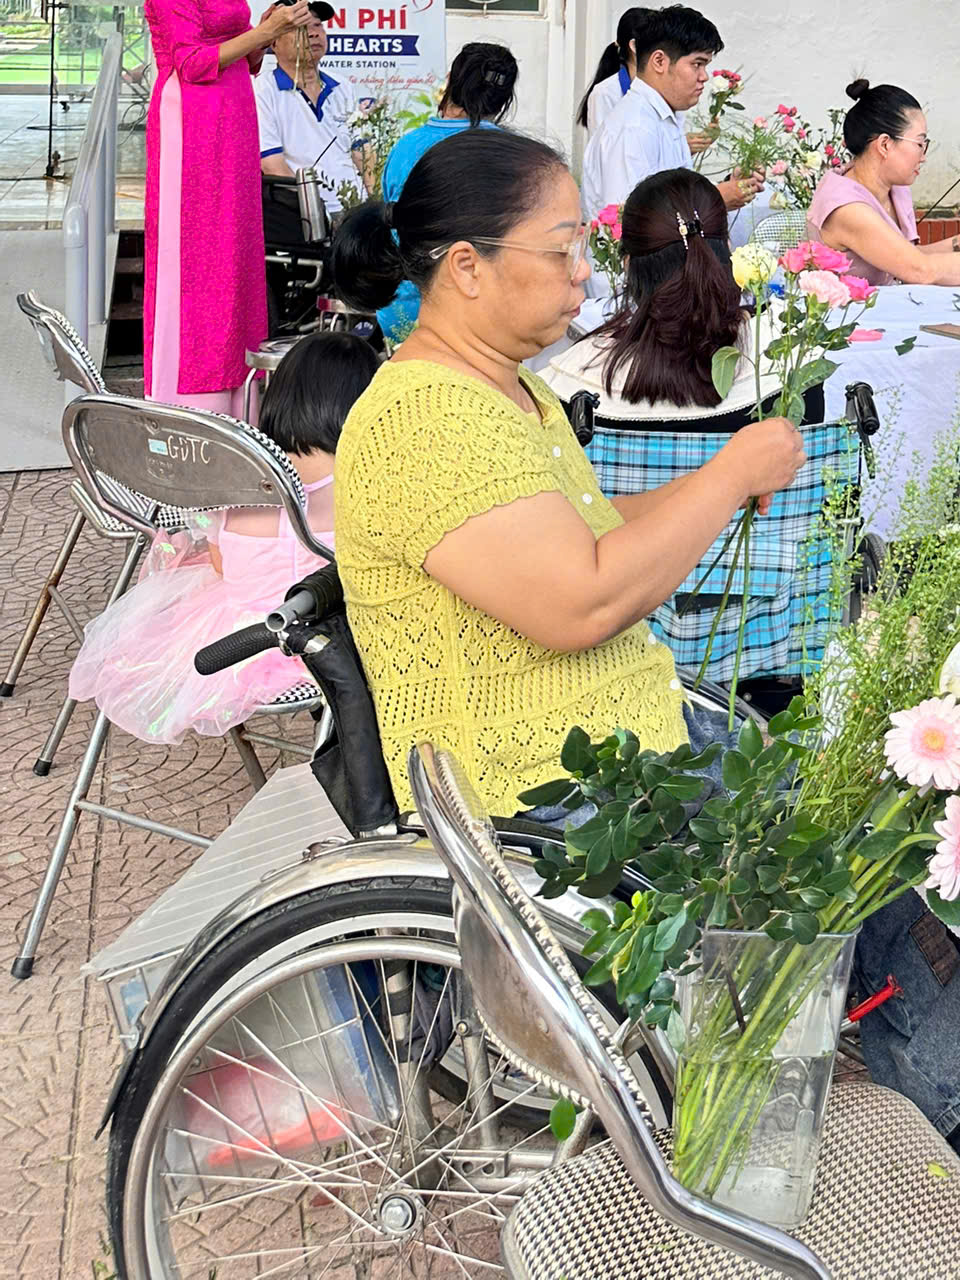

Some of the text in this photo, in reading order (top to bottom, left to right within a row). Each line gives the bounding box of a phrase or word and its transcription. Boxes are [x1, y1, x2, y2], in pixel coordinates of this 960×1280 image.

[358, 4, 408, 30] PHÍ
[329, 38, 403, 54] HEARTS
[320, 60, 396, 68] WATER STATION
